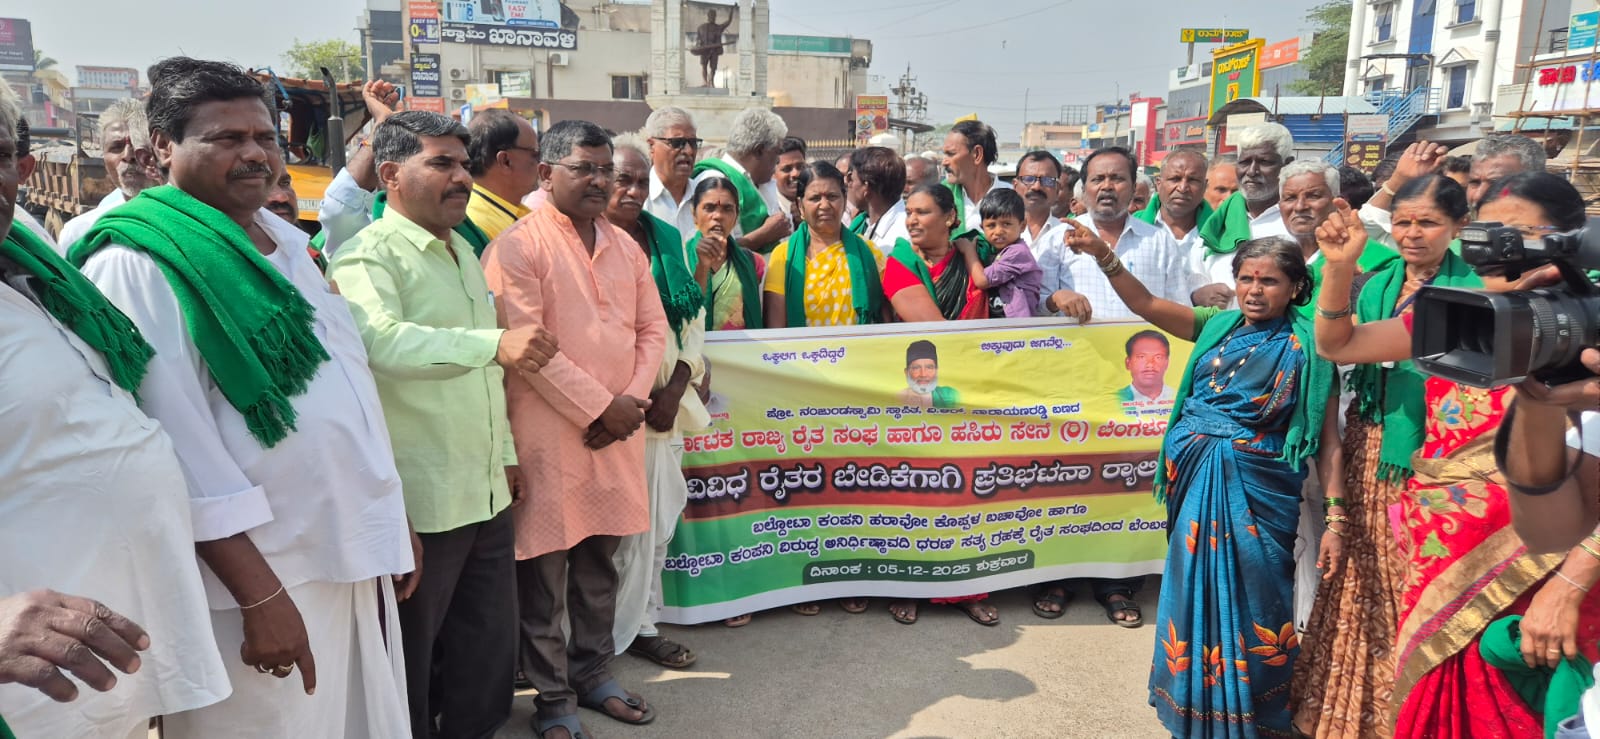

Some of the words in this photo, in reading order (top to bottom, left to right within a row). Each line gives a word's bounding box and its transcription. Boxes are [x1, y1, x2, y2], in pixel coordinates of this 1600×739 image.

[489, 28, 576, 48] ಖಾನಾವಳಿ
[762, 351, 797, 364] ಒಕ್ಕಲಿಗ
[800, 406, 881, 418] ನಂಜುಂಡಸ್ವಾಮಿ
[1052, 403, 1080, 414] ಬಣದ
[742, 431, 786, 453] ರಾಜ್ಯ
[792, 425, 824, 452] ರೈತ
[833, 424, 878, 446] ಸಂಘ
[887, 423, 942, 443] ಹಾಗೂ
[951, 421, 1002, 442] ಹಸಿರು
[1060, 421, 1089, 442] (ರಿ)
[1097, 420, 1168, 437] ಬೆಂಗಳೂ
[687, 469, 747, 499] ವಿವಿಧ
[760, 465, 822, 499] ರೈತರ
[834, 464, 962, 488] ಬೇಡಿಕೆಗಾಗಿ
[974, 463, 1091, 494] ಪ್ರತಿಭಟನಾ
[818, 513, 864, 527] ಕಂಪನಿ
[934, 513, 980, 529] ಕೊಪ್ಪಳ
[986, 506, 1042, 522] ಬಚಾವೋ
[1048, 503, 1087, 516] ಹಾಗೂ
[730, 543, 773, 561] ಕಂಪನಿ
[961, 534, 986, 551] ಸತ್ಯ
[990, 527, 1026, 544] ಗ್ರಹಕ್ಕೆ
[1030, 525, 1054, 541] ರೈತ
[1059, 519, 1123, 535] ಸಂಘದಿಂದ
[810, 563, 862, 577] ದಿನಾಂಕ
[976, 554, 1029, 572] ಶುಕ್ರವಾರ
